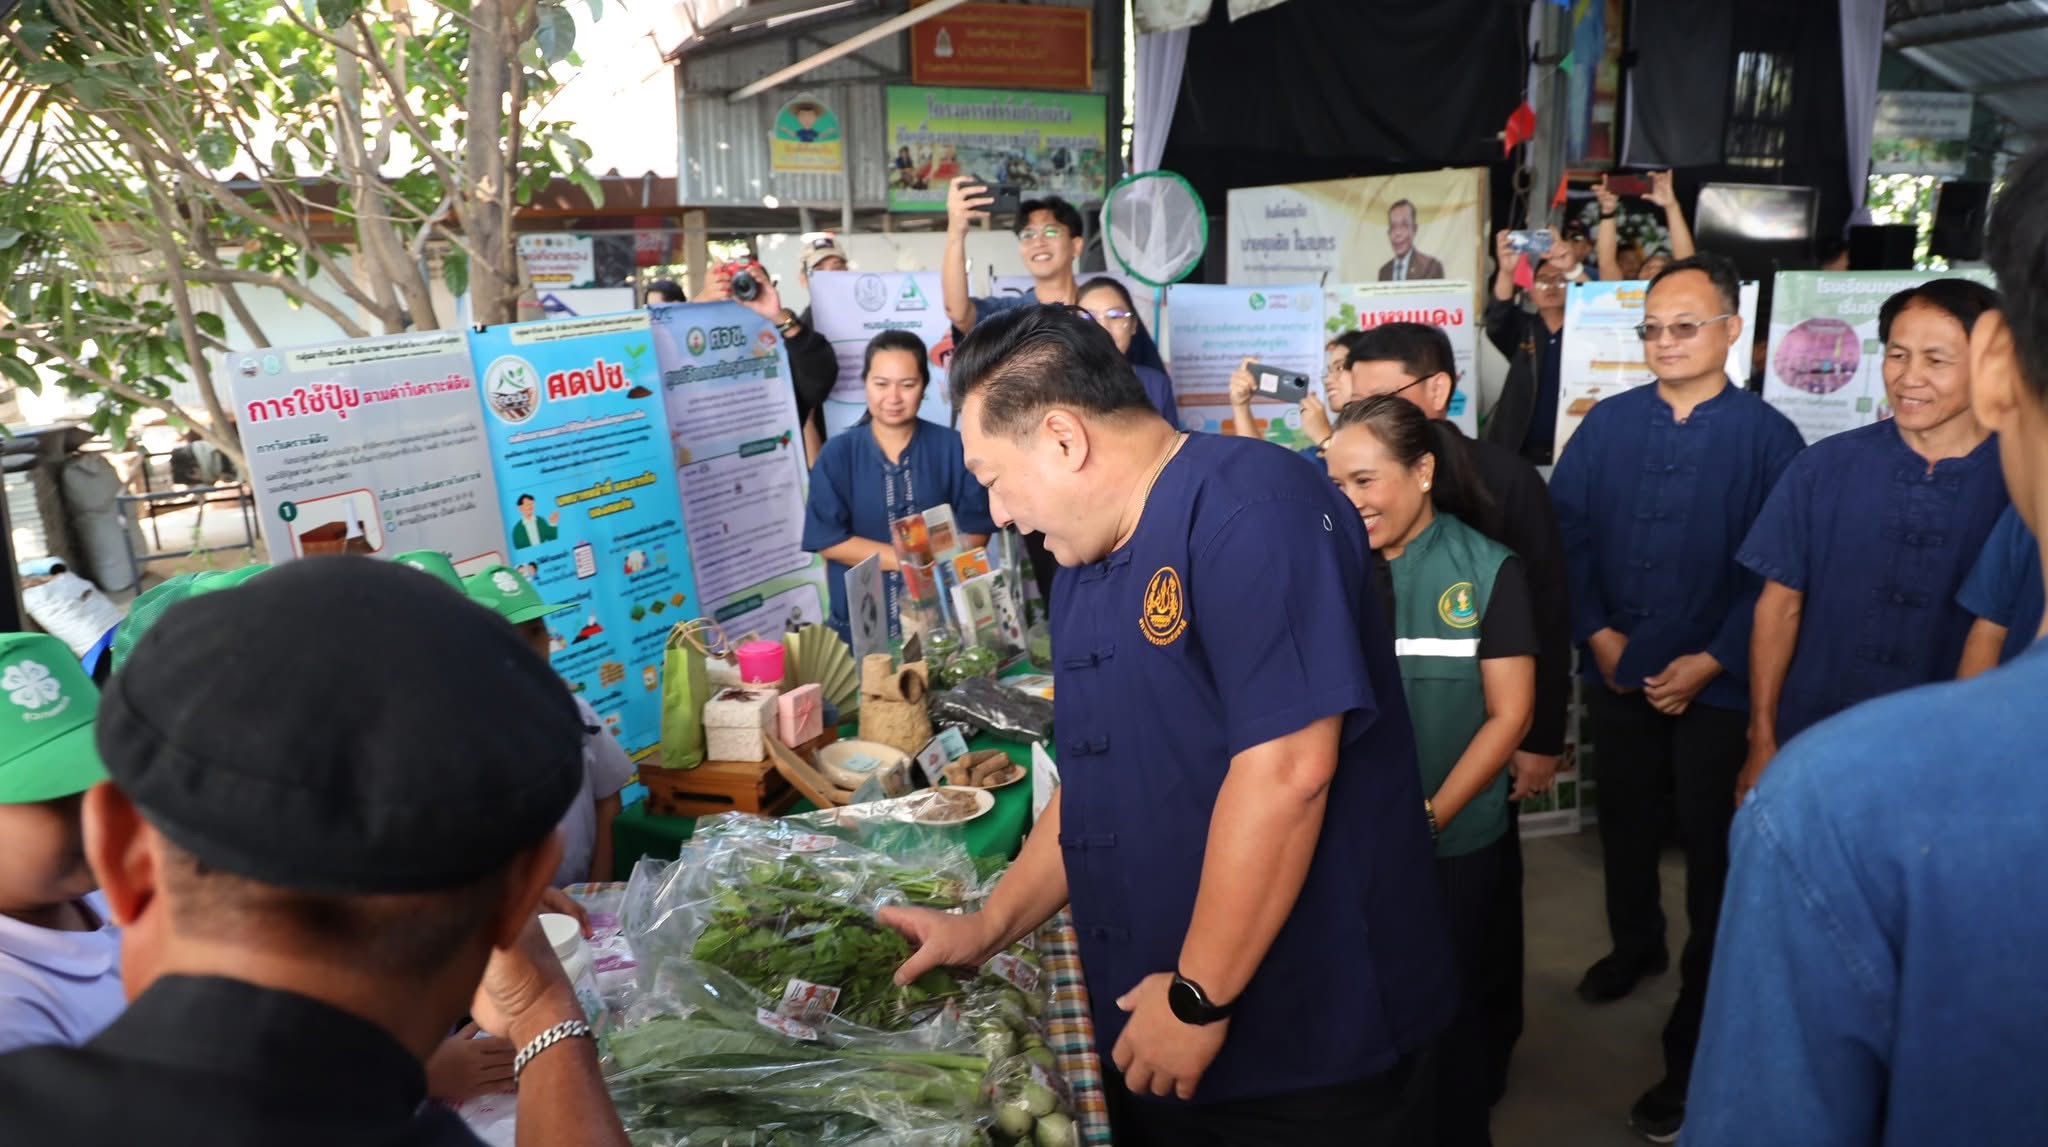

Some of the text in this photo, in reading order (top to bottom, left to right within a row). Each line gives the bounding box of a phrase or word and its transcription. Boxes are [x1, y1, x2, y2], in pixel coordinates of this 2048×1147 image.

[248, 383, 359, 421] การใช้ปุ๋ย
[363, 375, 471, 404] ตามค่าวิเคราะห์ดิน
[547, 360, 630, 401] ศดปช.
[283, 506, 292, 518] 1
